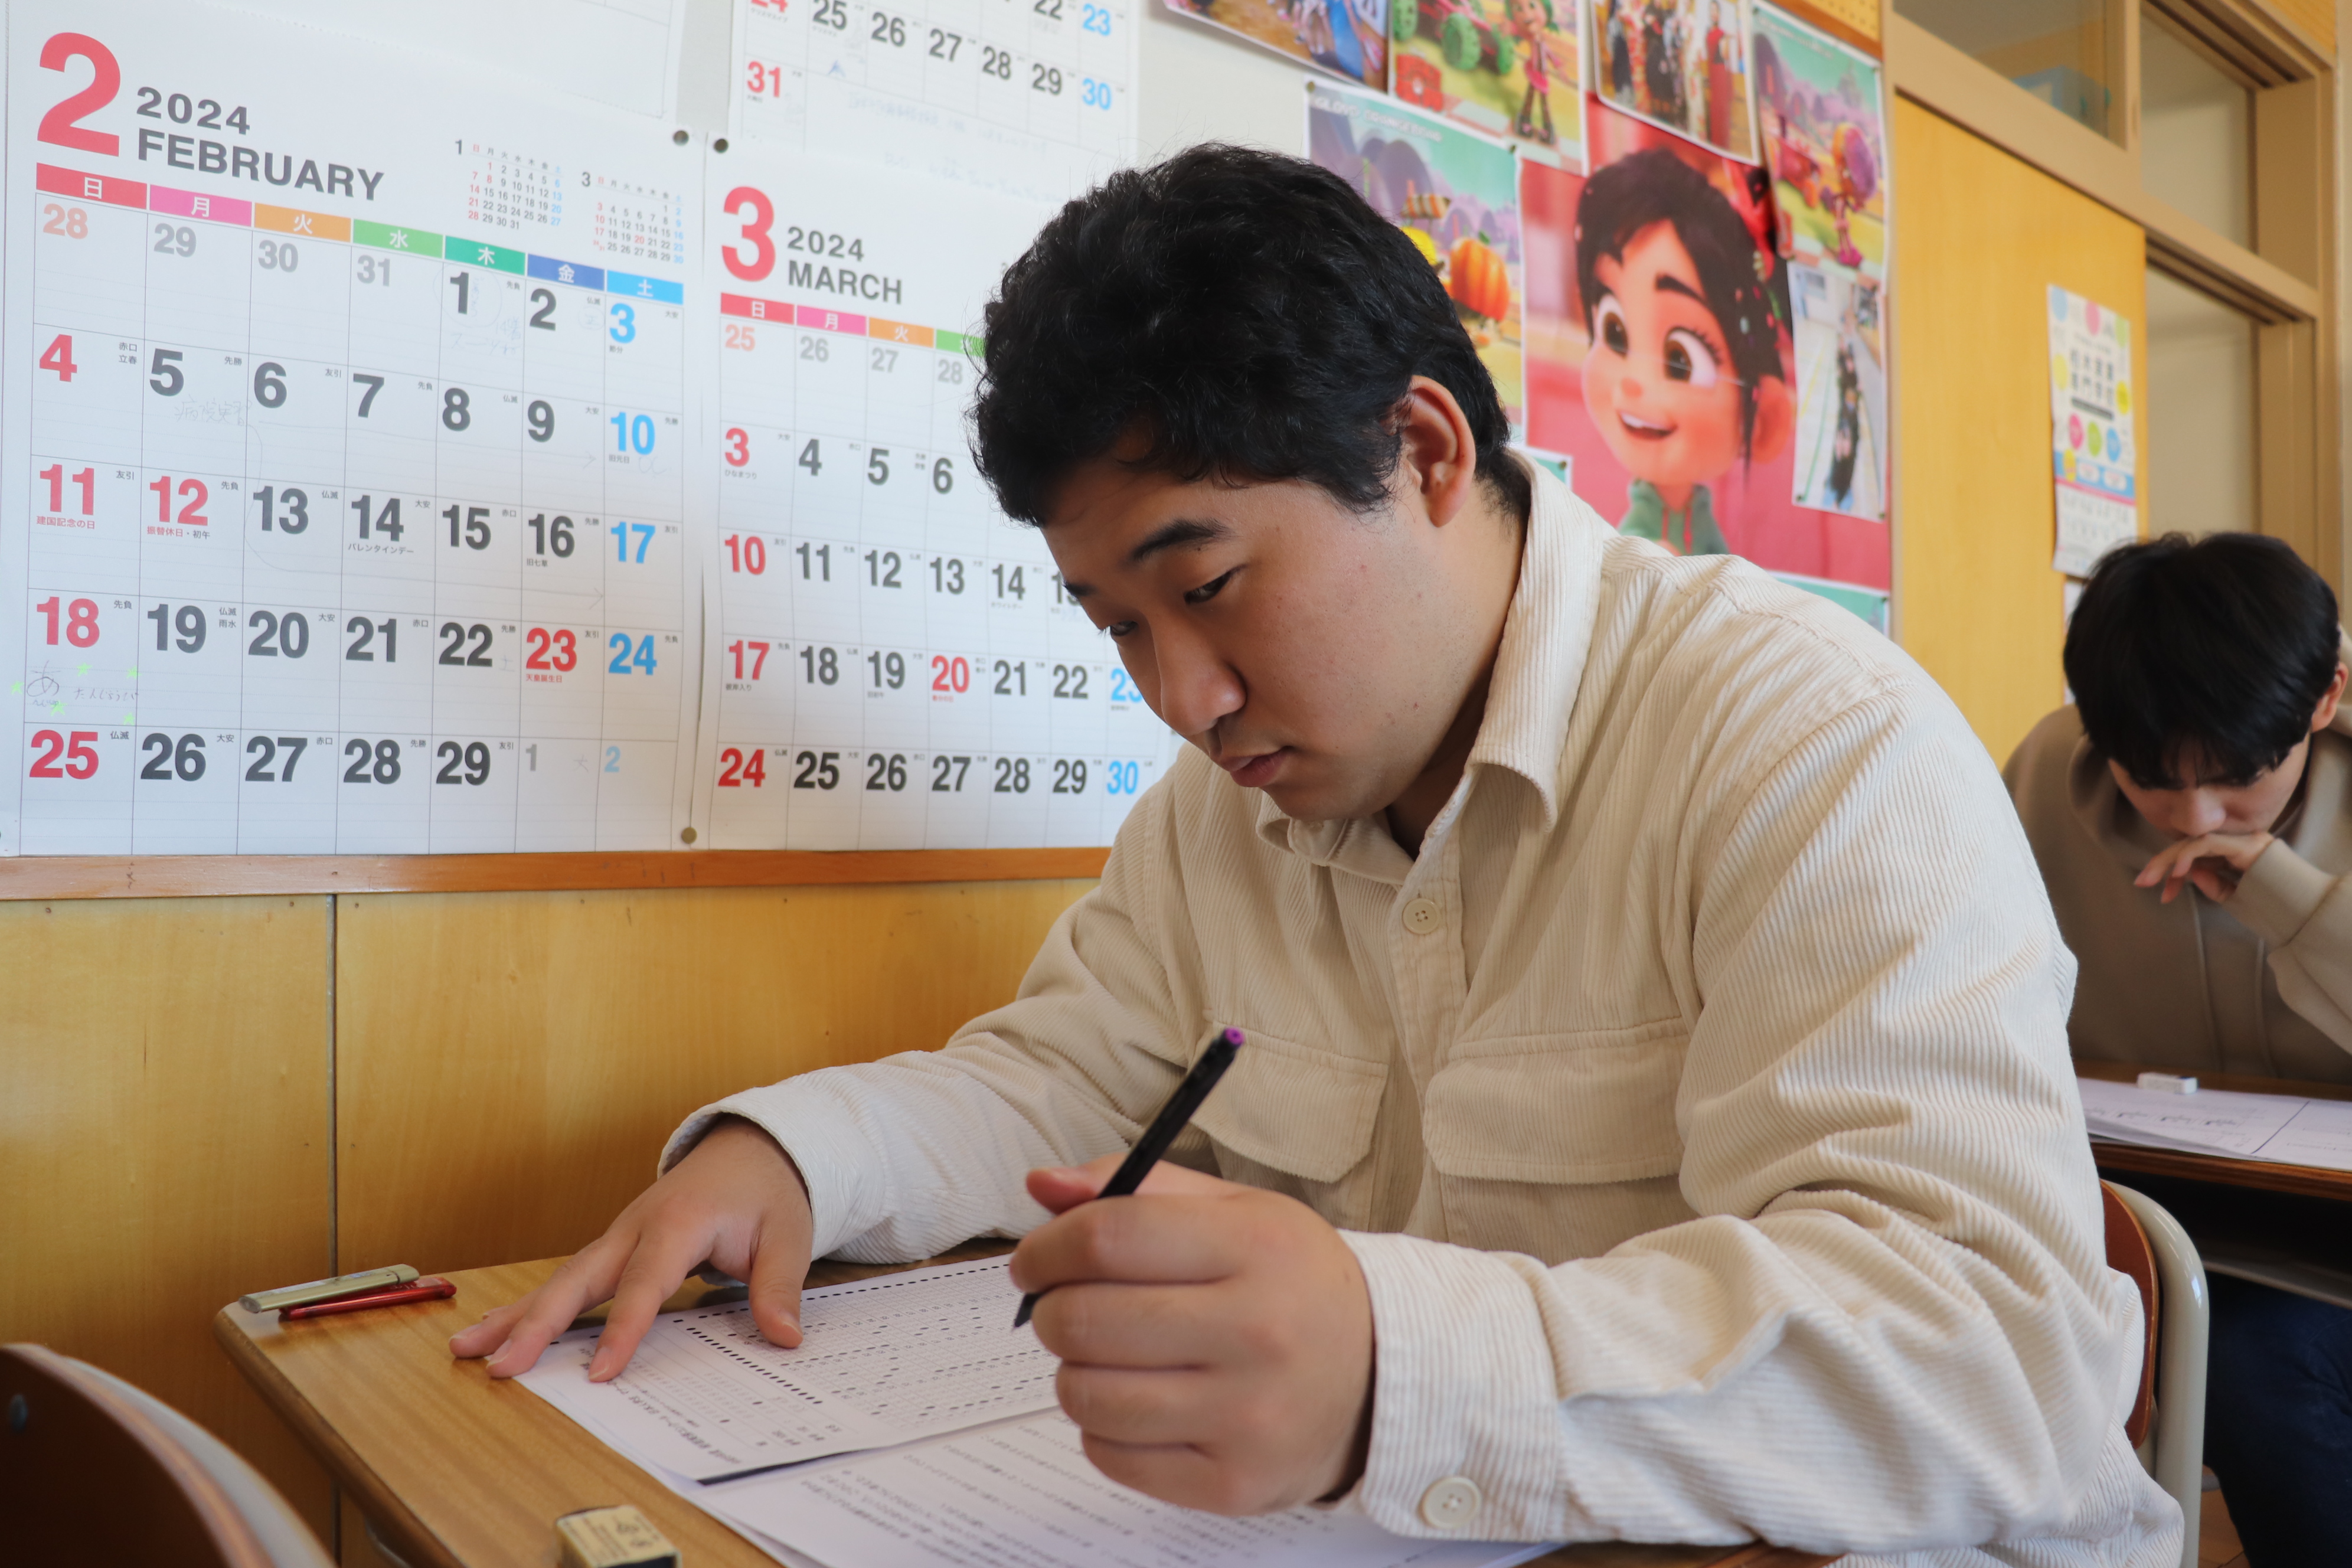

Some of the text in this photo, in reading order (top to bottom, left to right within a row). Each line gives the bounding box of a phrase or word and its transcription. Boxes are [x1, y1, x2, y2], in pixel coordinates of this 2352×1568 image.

[1083, 4, 1110, 36] 23
[747, 61, 780, 97] 31
[813, 0, 1112, 110] 25 26 27 28 29 30
[37, 32, 120, 156] 2
[136, 86, 250, 135] 2024
[138, 128, 384, 201] FEBRUARY
[469, 197, 560, 226] 21 22 23 24 25 26 27
[469, 211, 519, 229] 28 29 30 31
[722, 187, 775, 282] 3
[84, 177, 653, 297] 日 月 火 水 木 金 土
[788, 227, 864, 261] 2024
[43, 204, 88, 239] 28
[154, 223, 196, 257] 29
[259, 240, 298, 272] 30
[357, 255, 390, 286] 31
[450, 272, 469, 314] 1
[530, 288, 556, 331] 2
[610, 303, 635, 343] 3
[789, 260, 901, 304] MARCH
[752, 301, 765, 318] 日
[825, 313, 838, 330] 月
[896, 326, 908, 341] 火
[119, 354, 138, 365] 立春
[725, 324, 962, 385] 25 26 27 28
[40, 334, 655, 455] 4 5 6 7 8 9 10
[725, 428, 749, 466] 3
[799, 439, 822, 476] 4
[868, 448, 888, 485] 5
[933, 458, 953, 494] 6
[37, 516, 94, 529] 建国記念の日
[40, 464, 655, 563] 11 12 13 14 15 16 17
[148, 526, 210, 539] 振替休日・初午
[348, 544, 414, 554] バレンタインデー
[725, 534, 765, 575] 10
[796, 543, 829, 582] 11
[865, 550, 901, 588] 12
[930, 557, 964, 594] 13
[992, 564, 1025, 600] 14
[37, 597, 656, 675] 18 19 20 21 22 23 24
[218, 619, 236, 629] 雨水
[526, 674, 563, 683] 天皇誕生日
[729, 640, 769, 680] 17
[801, 646, 838, 685] 18
[868, 651, 905, 689] 19
[932, 655, 969, 692] 20
[994, 660, 1025, 695] 21
[1053, 664, 1088, 699] 22
[30, 730, 620, 785] 25 26 27 28 29 1 2
[718, 748, 1138, 795] 24 25 26 27 28 29 30
